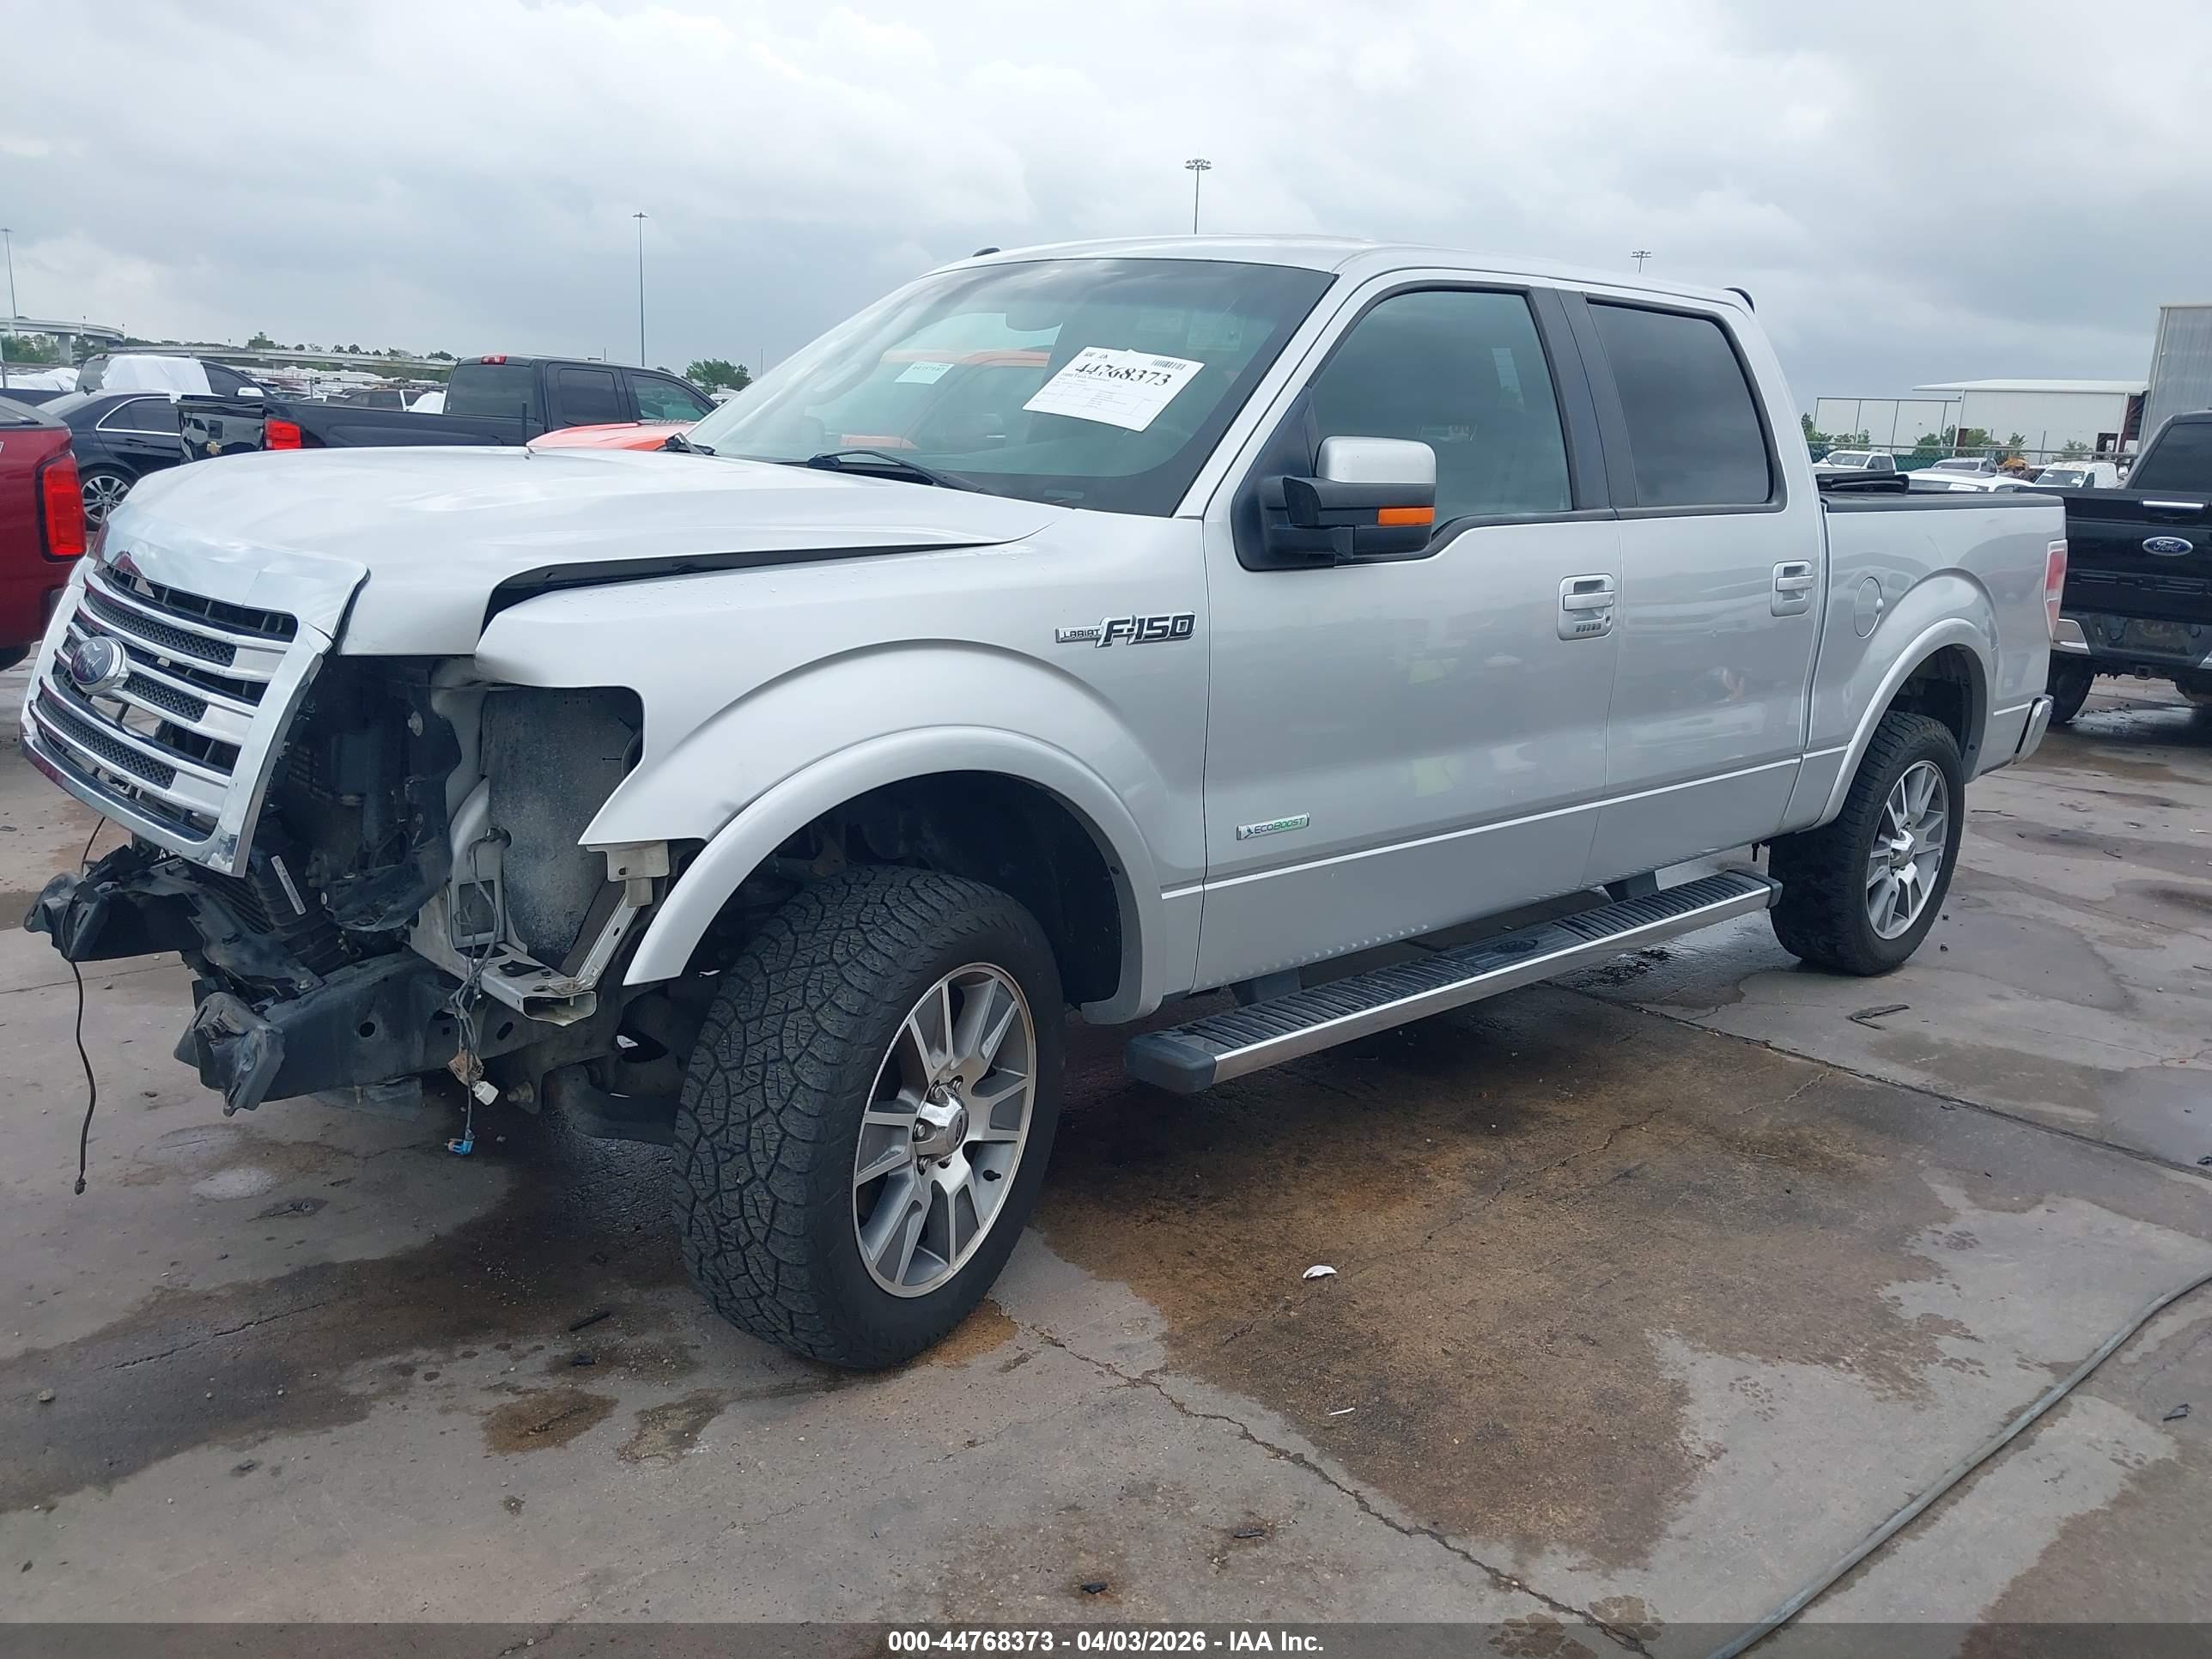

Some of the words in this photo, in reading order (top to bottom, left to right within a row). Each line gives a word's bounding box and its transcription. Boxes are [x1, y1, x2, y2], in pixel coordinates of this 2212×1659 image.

[1075, 362, 1172, 386] 44768373
[1063, 629, 1101, 640] LARIAT
[1097, 611, 1196, 647] F-150
[1254, 817, 1305, 835] ECOBOOST
